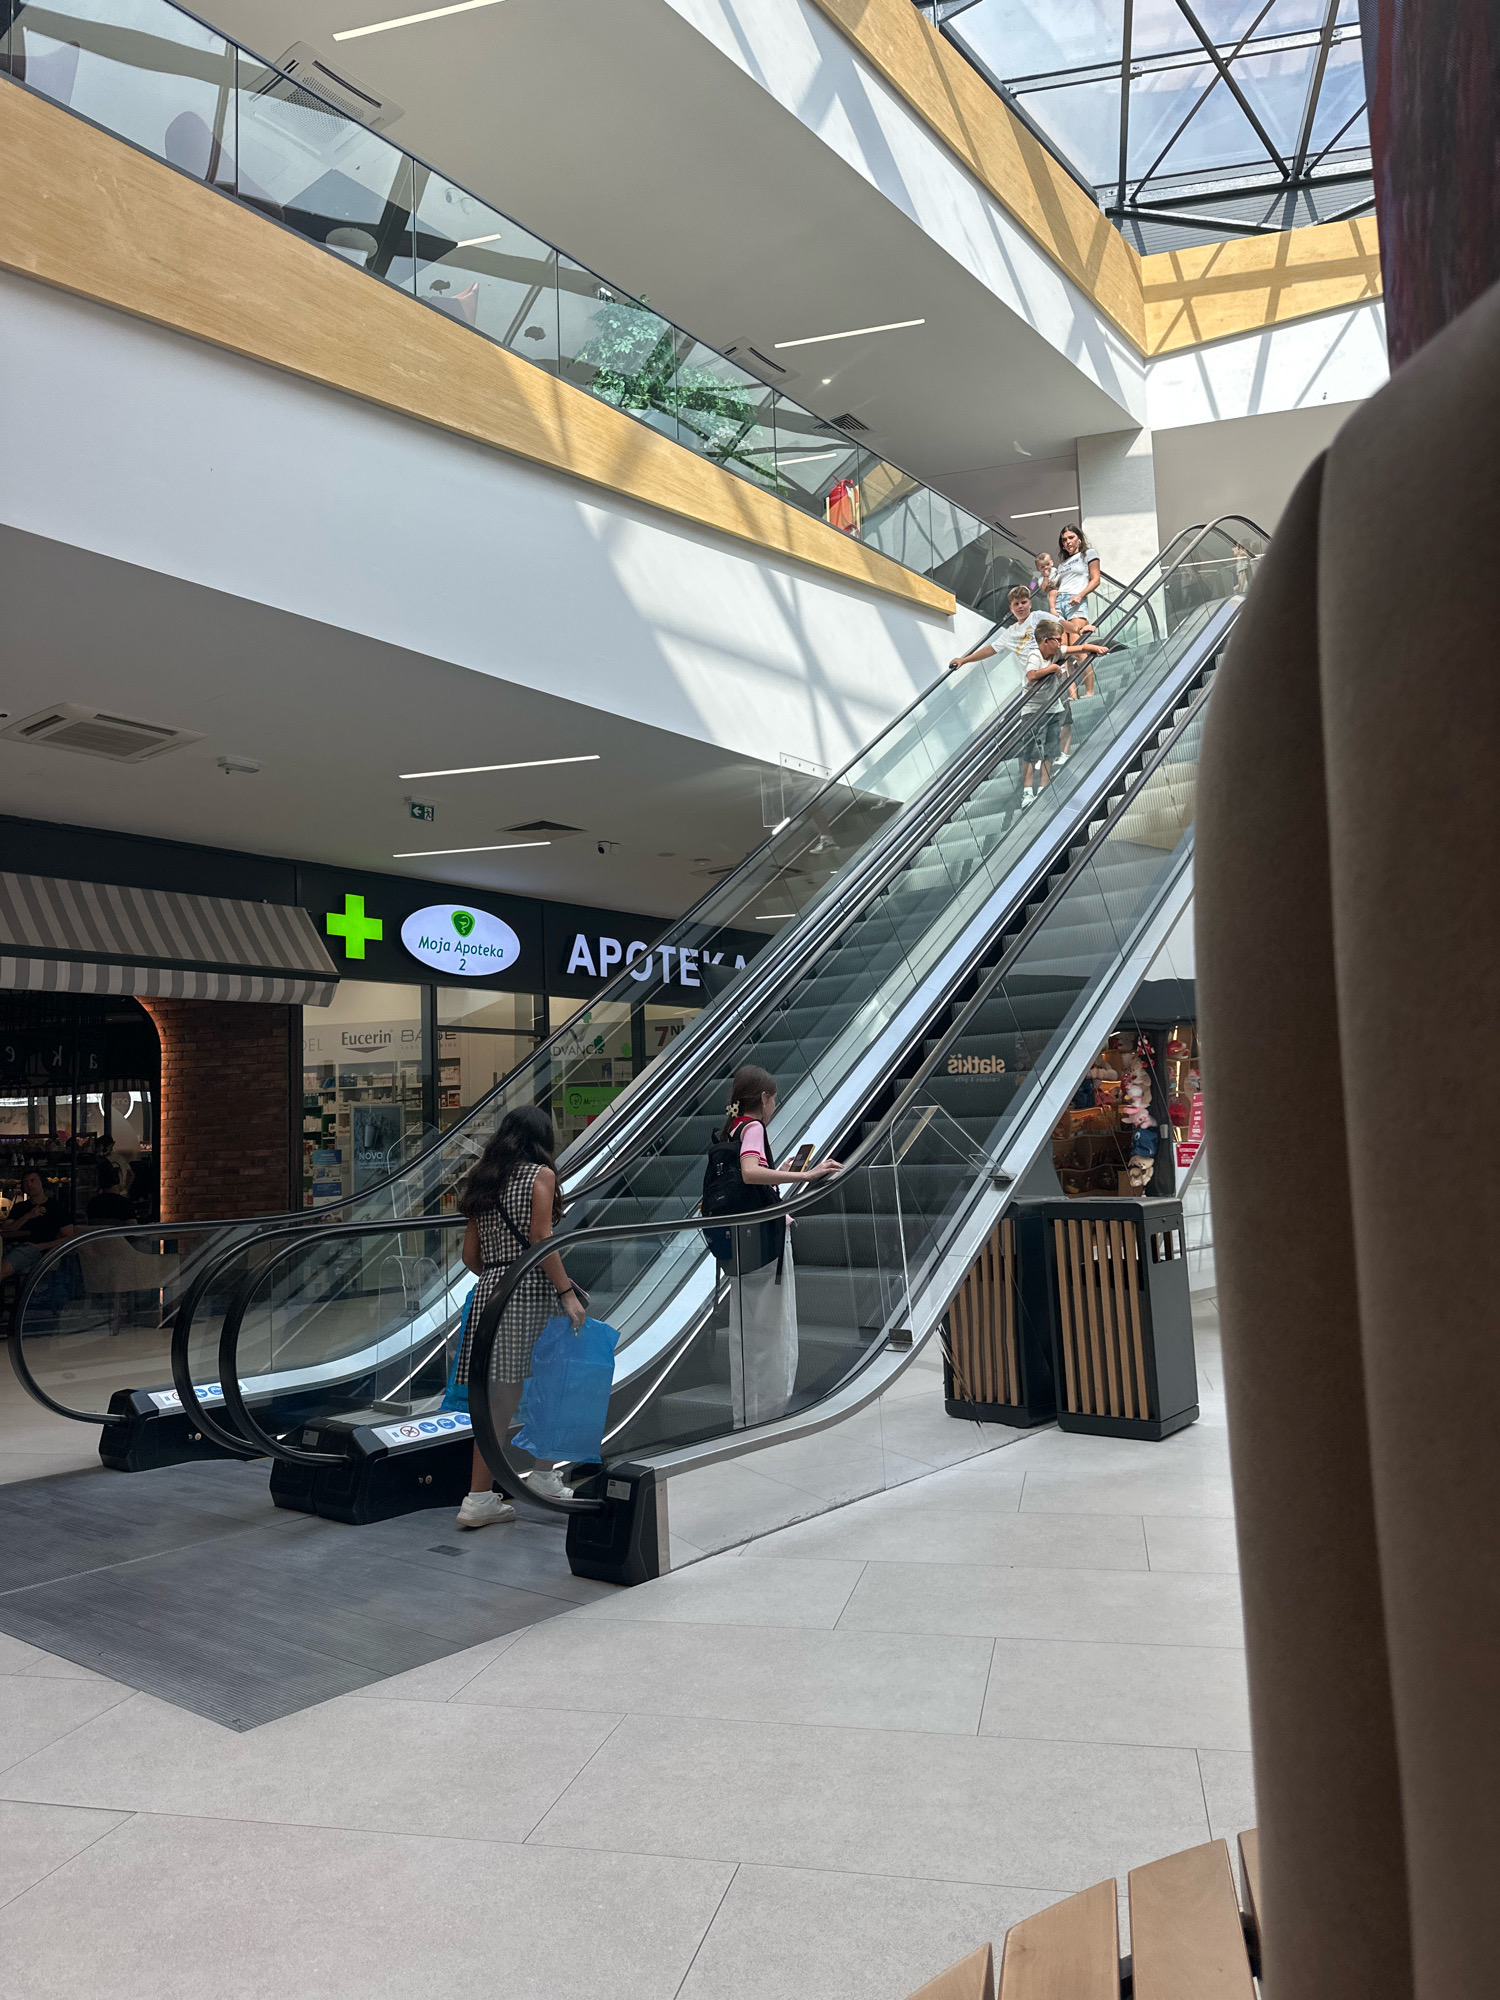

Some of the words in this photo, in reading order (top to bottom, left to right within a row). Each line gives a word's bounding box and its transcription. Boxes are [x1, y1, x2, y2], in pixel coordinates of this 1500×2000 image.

[418, 935, 451, 954] Moja
[454, 940, 504, 958] Apoteka
[458, 958, 467, 971] 2
[341, 1029, 392, 1046] Eucerin
[358, 1151, 383, 1161] NOVO
